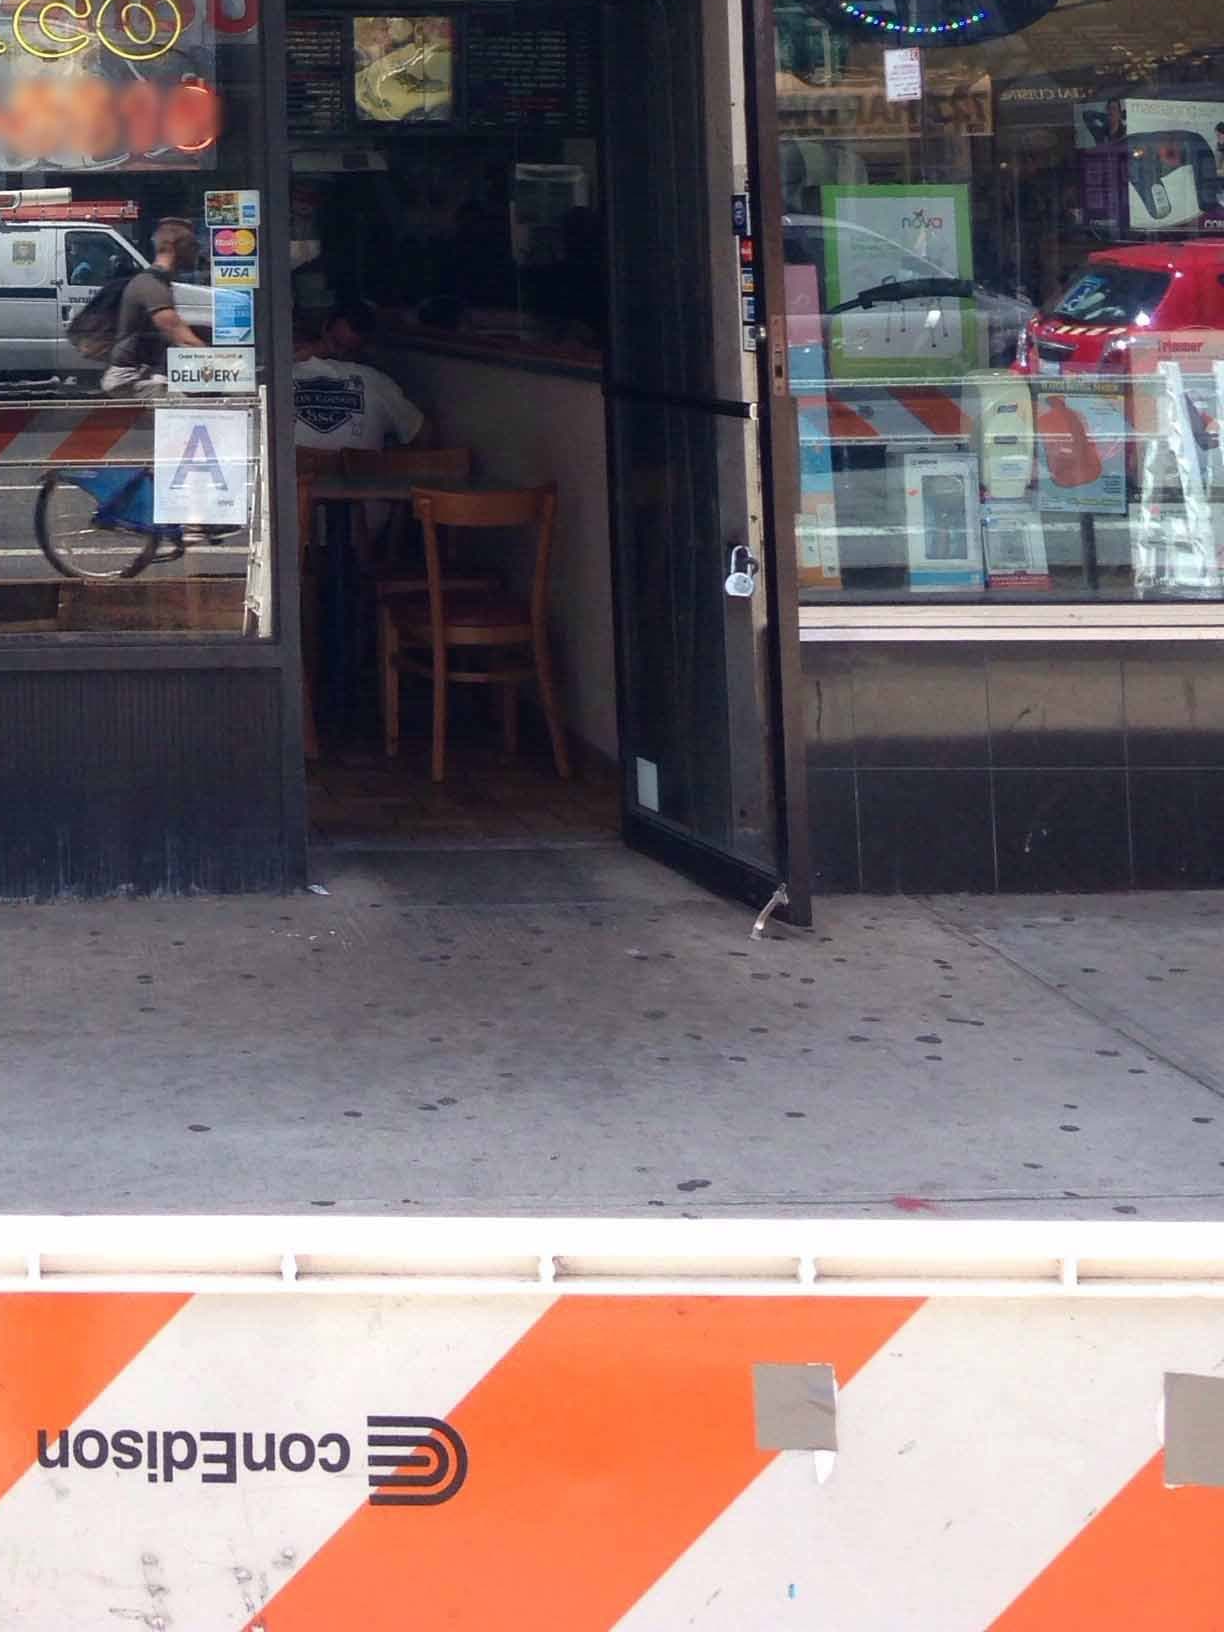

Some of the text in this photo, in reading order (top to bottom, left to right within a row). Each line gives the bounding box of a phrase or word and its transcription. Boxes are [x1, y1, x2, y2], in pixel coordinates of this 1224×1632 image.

[220, 267, 250, 278] VISA
[171, 368, 240, 383] DELIVERY
[169, 423, 229, 491] A
[36, 1429, 351, 1484] conEdison
